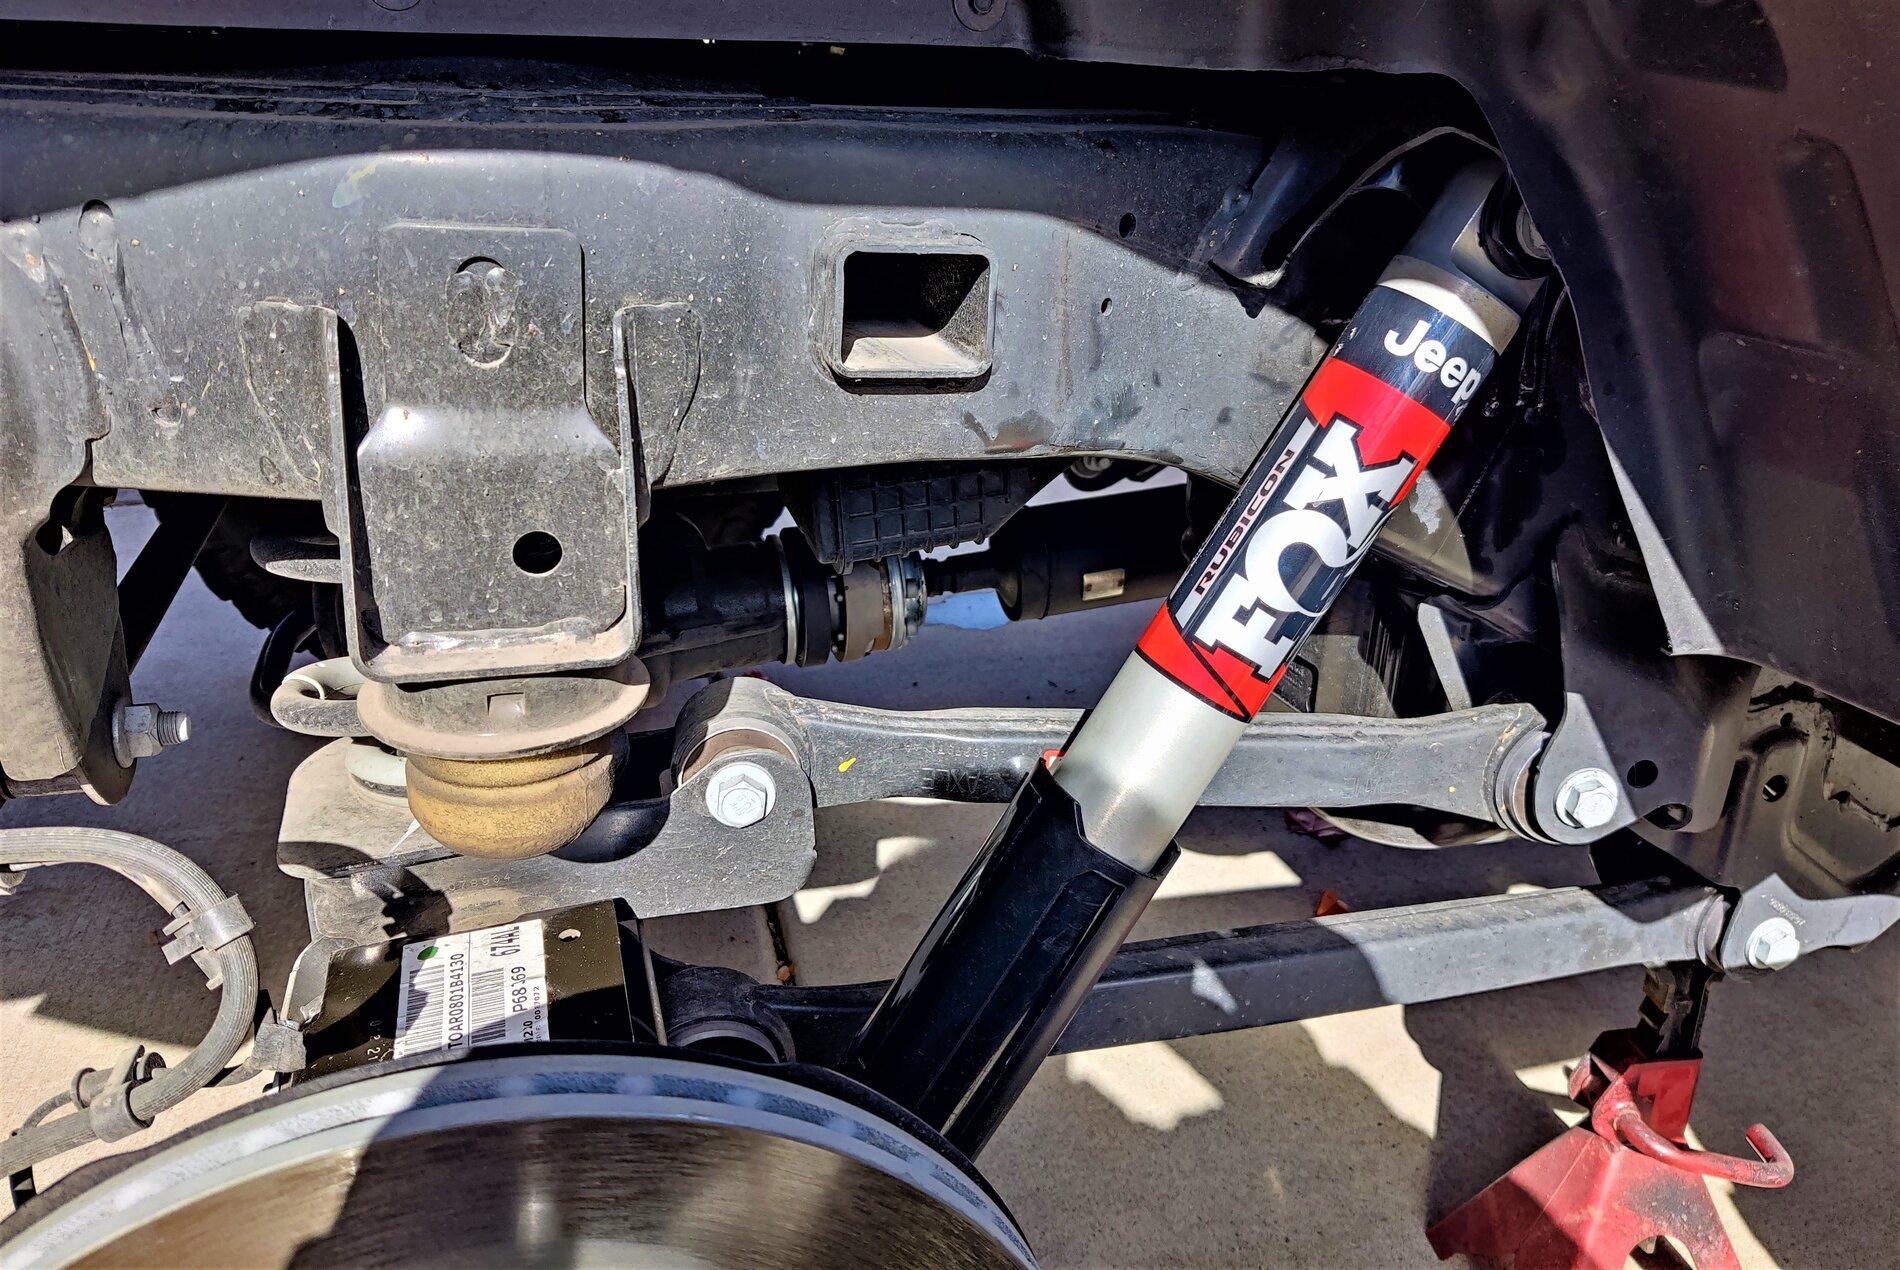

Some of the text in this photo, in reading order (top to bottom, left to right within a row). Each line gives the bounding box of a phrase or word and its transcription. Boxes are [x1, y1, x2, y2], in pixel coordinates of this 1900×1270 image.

[1383, 319, 1482, 404] Jeep
[1194, 449, 1295, 596] RUBICON
[1194, 418, 1419, 679] FOX
[489, 926, 521, 957] 674AL
